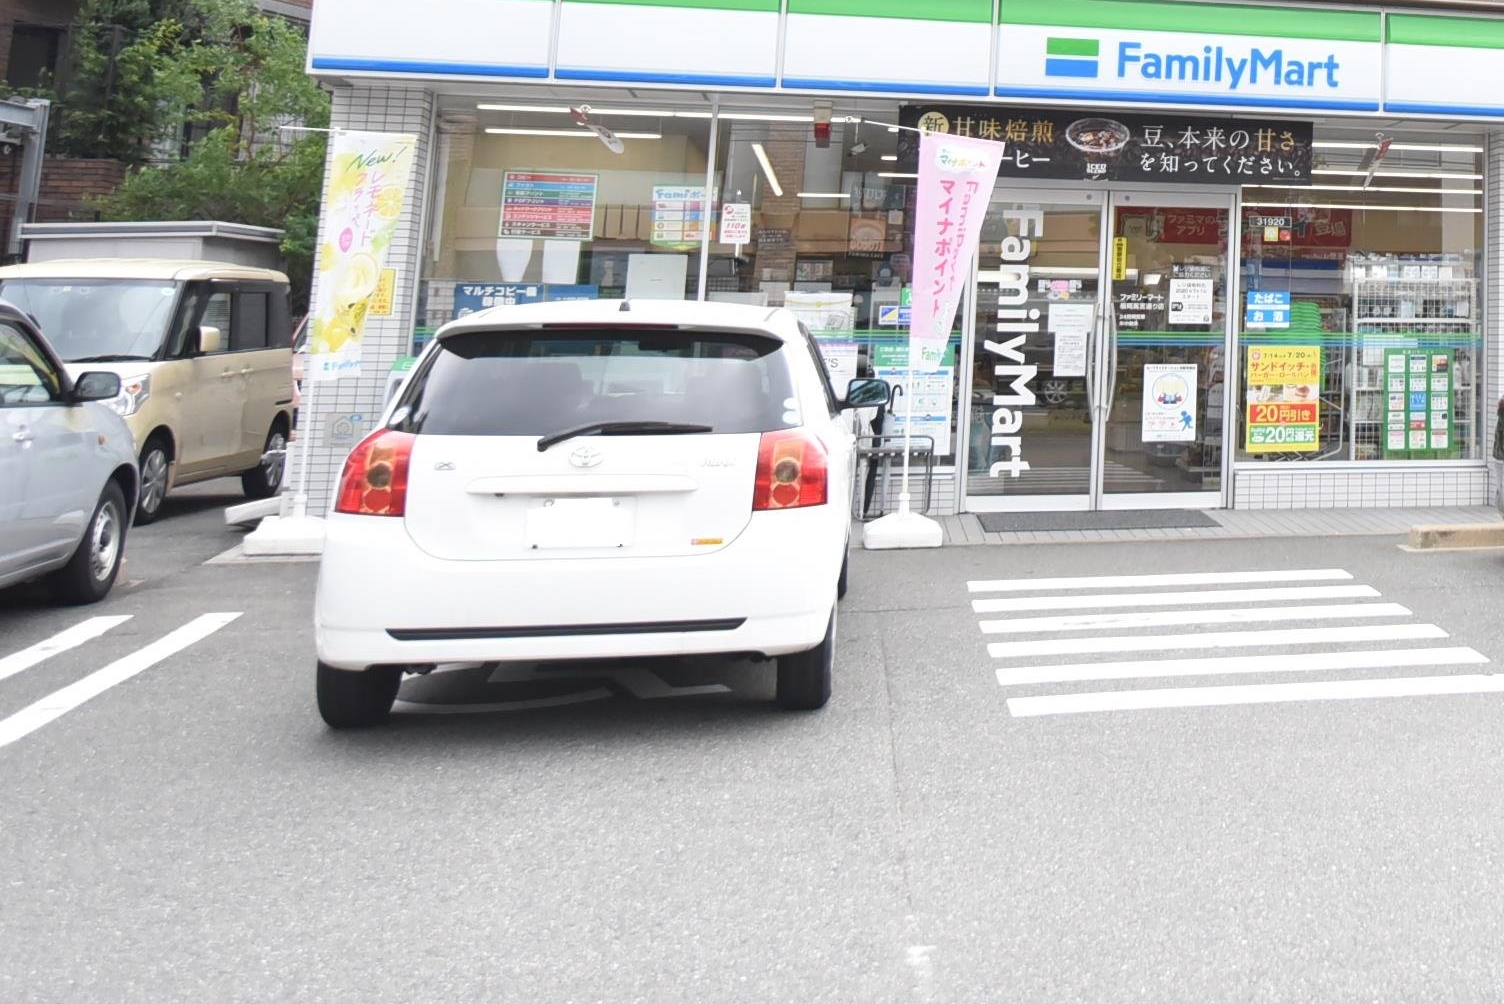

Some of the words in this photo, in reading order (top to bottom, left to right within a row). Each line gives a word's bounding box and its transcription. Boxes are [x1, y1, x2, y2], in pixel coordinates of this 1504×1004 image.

[1117, 41, 1340, 90] FamilyMart
[1140, 124, 1296, 152] 豆、本来の甘さ
[1139, 153, 1301, 177] を知ってください。
[1256, 217, 1285, 226] 31920
[932, 179, 956, 317] マイナポイント
[1253, 293, 1284, 304] たばこ
[984, 210, 1044, 478] FamilyMart
